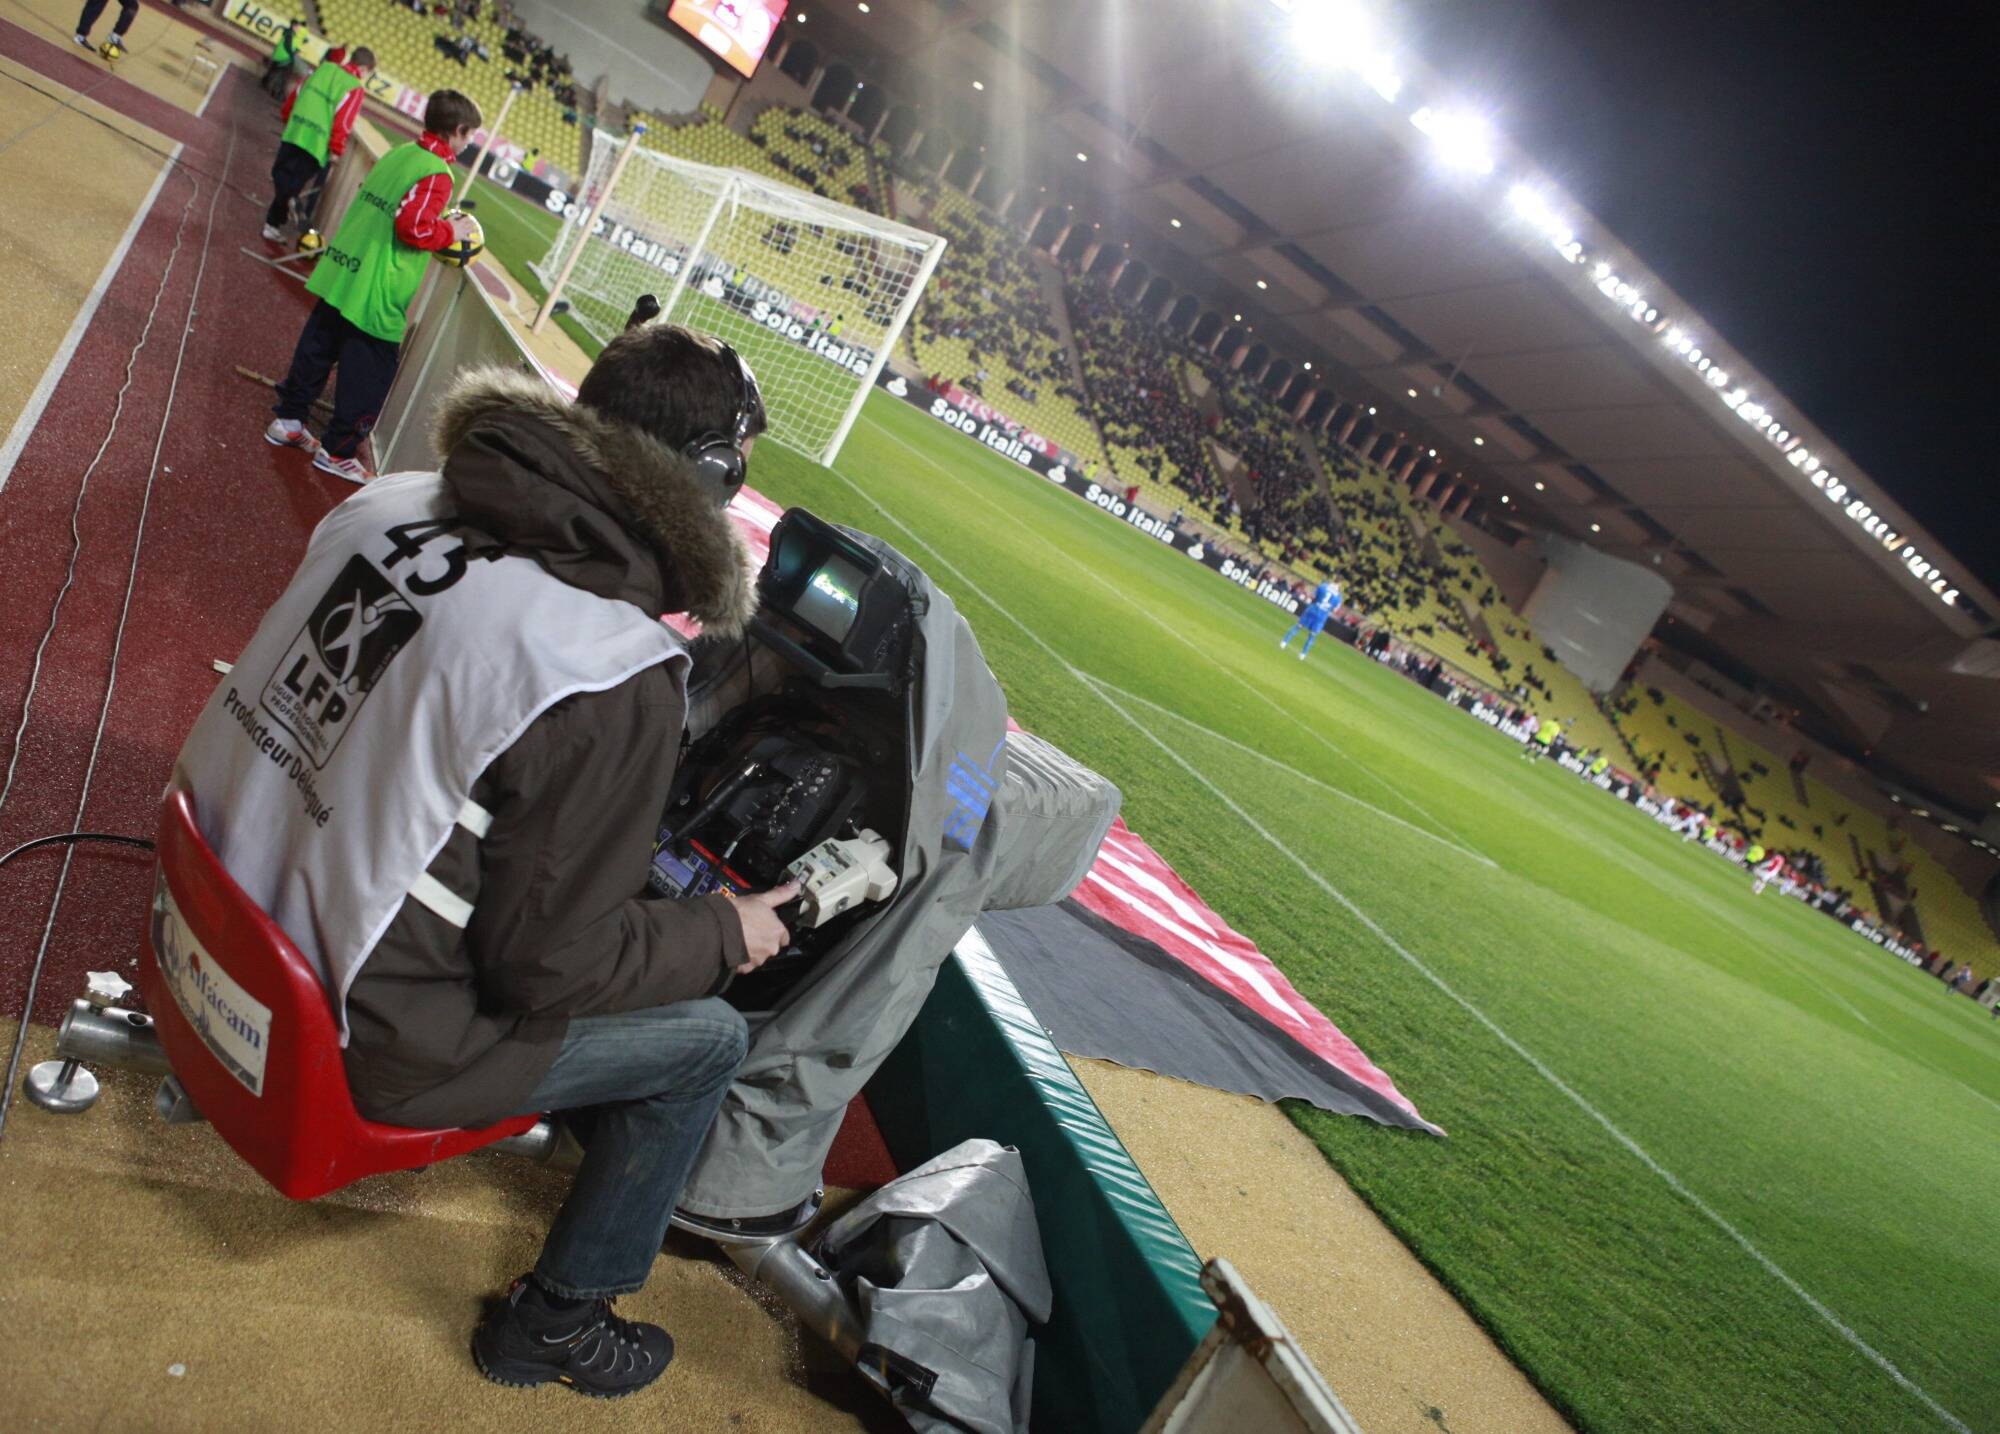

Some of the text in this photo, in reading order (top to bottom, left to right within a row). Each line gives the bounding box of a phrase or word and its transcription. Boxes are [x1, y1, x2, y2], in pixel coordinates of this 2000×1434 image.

[236, 1, 288, 38] Her
[545, 189, 680, 276] Solo Italia
[752, 301, 804, 341] Solo
[807, 330, 869, 376] Italia
[930, 398, 1033, 466] Solo Italia
[1085, 483, 1175, 545] Solo Italia
[1220, 559, 1299, 613] Sol Italia
[1316, 591, 1333, 612] 1
[270, 680, 294, 704] LIGUE
[300, 711, 330, 752] FOOALL
[283, 653, 347, 728] LFP
[1470, 701, 1499, 726] Solo
[223, 687, 334, 829] Producteur Délégué
[1581, 765, 1613, 790] Ilia
[1850, 918, 1923, 967] Solo Italia
